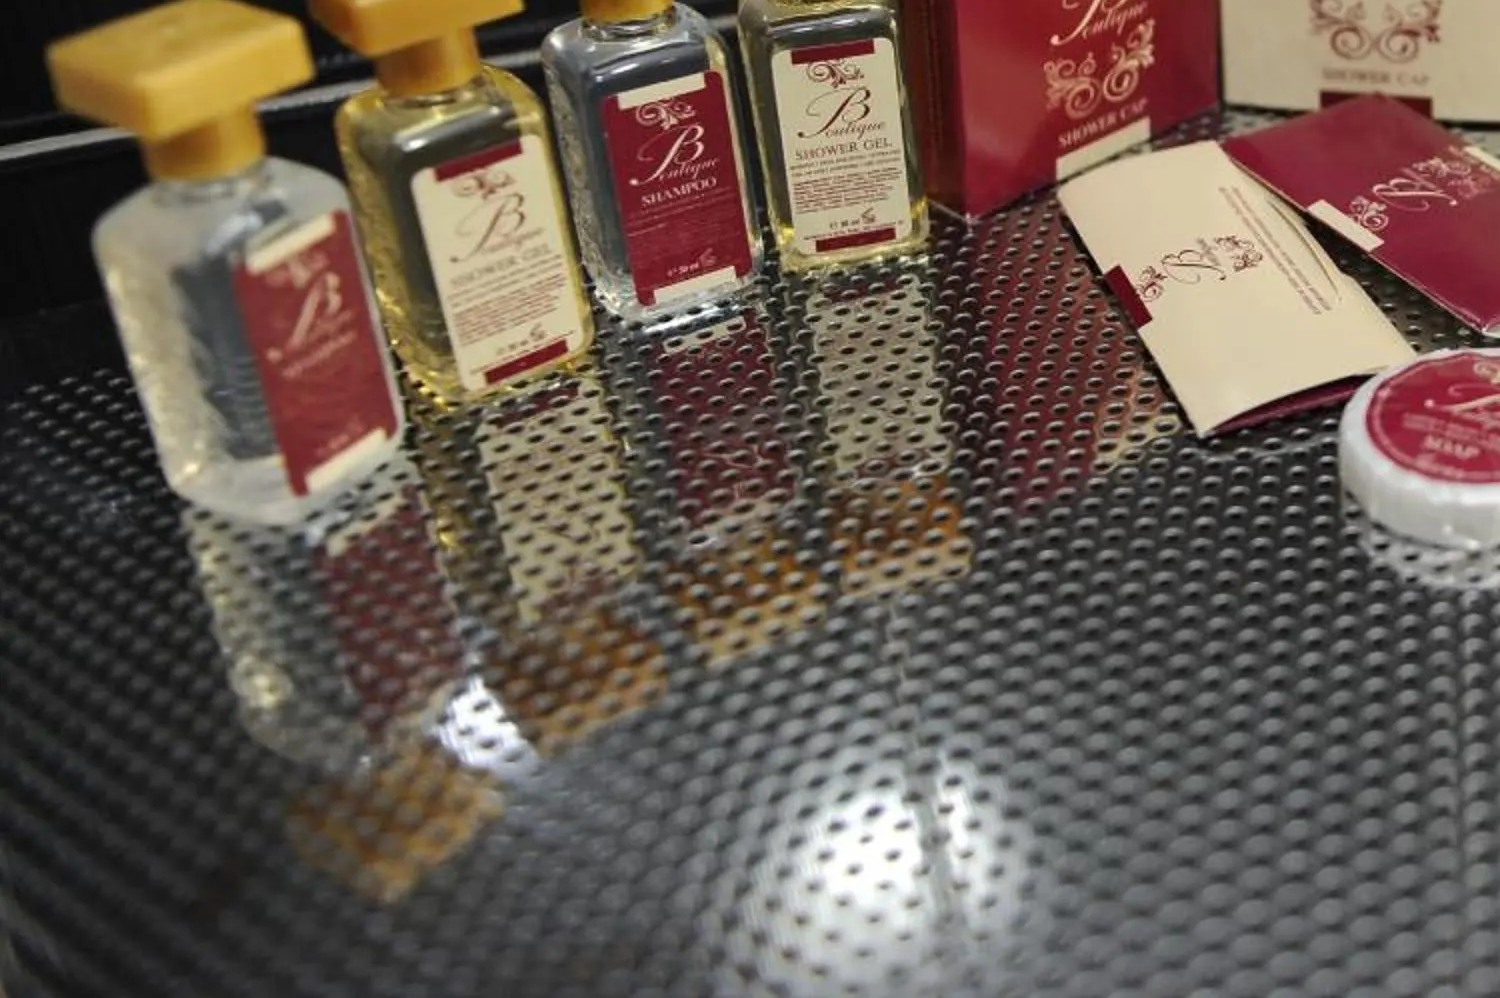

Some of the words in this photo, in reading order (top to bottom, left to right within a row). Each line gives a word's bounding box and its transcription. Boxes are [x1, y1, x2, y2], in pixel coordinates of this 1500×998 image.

[1058, 111, 1117, 149] SHOWER
[1119, 97, 1148, 119] CAP
[795, 142, 858, 161] SHOWER
[863, 137, 893, 151] GEL
[641, 176, 717, 206] SHAMPOO
